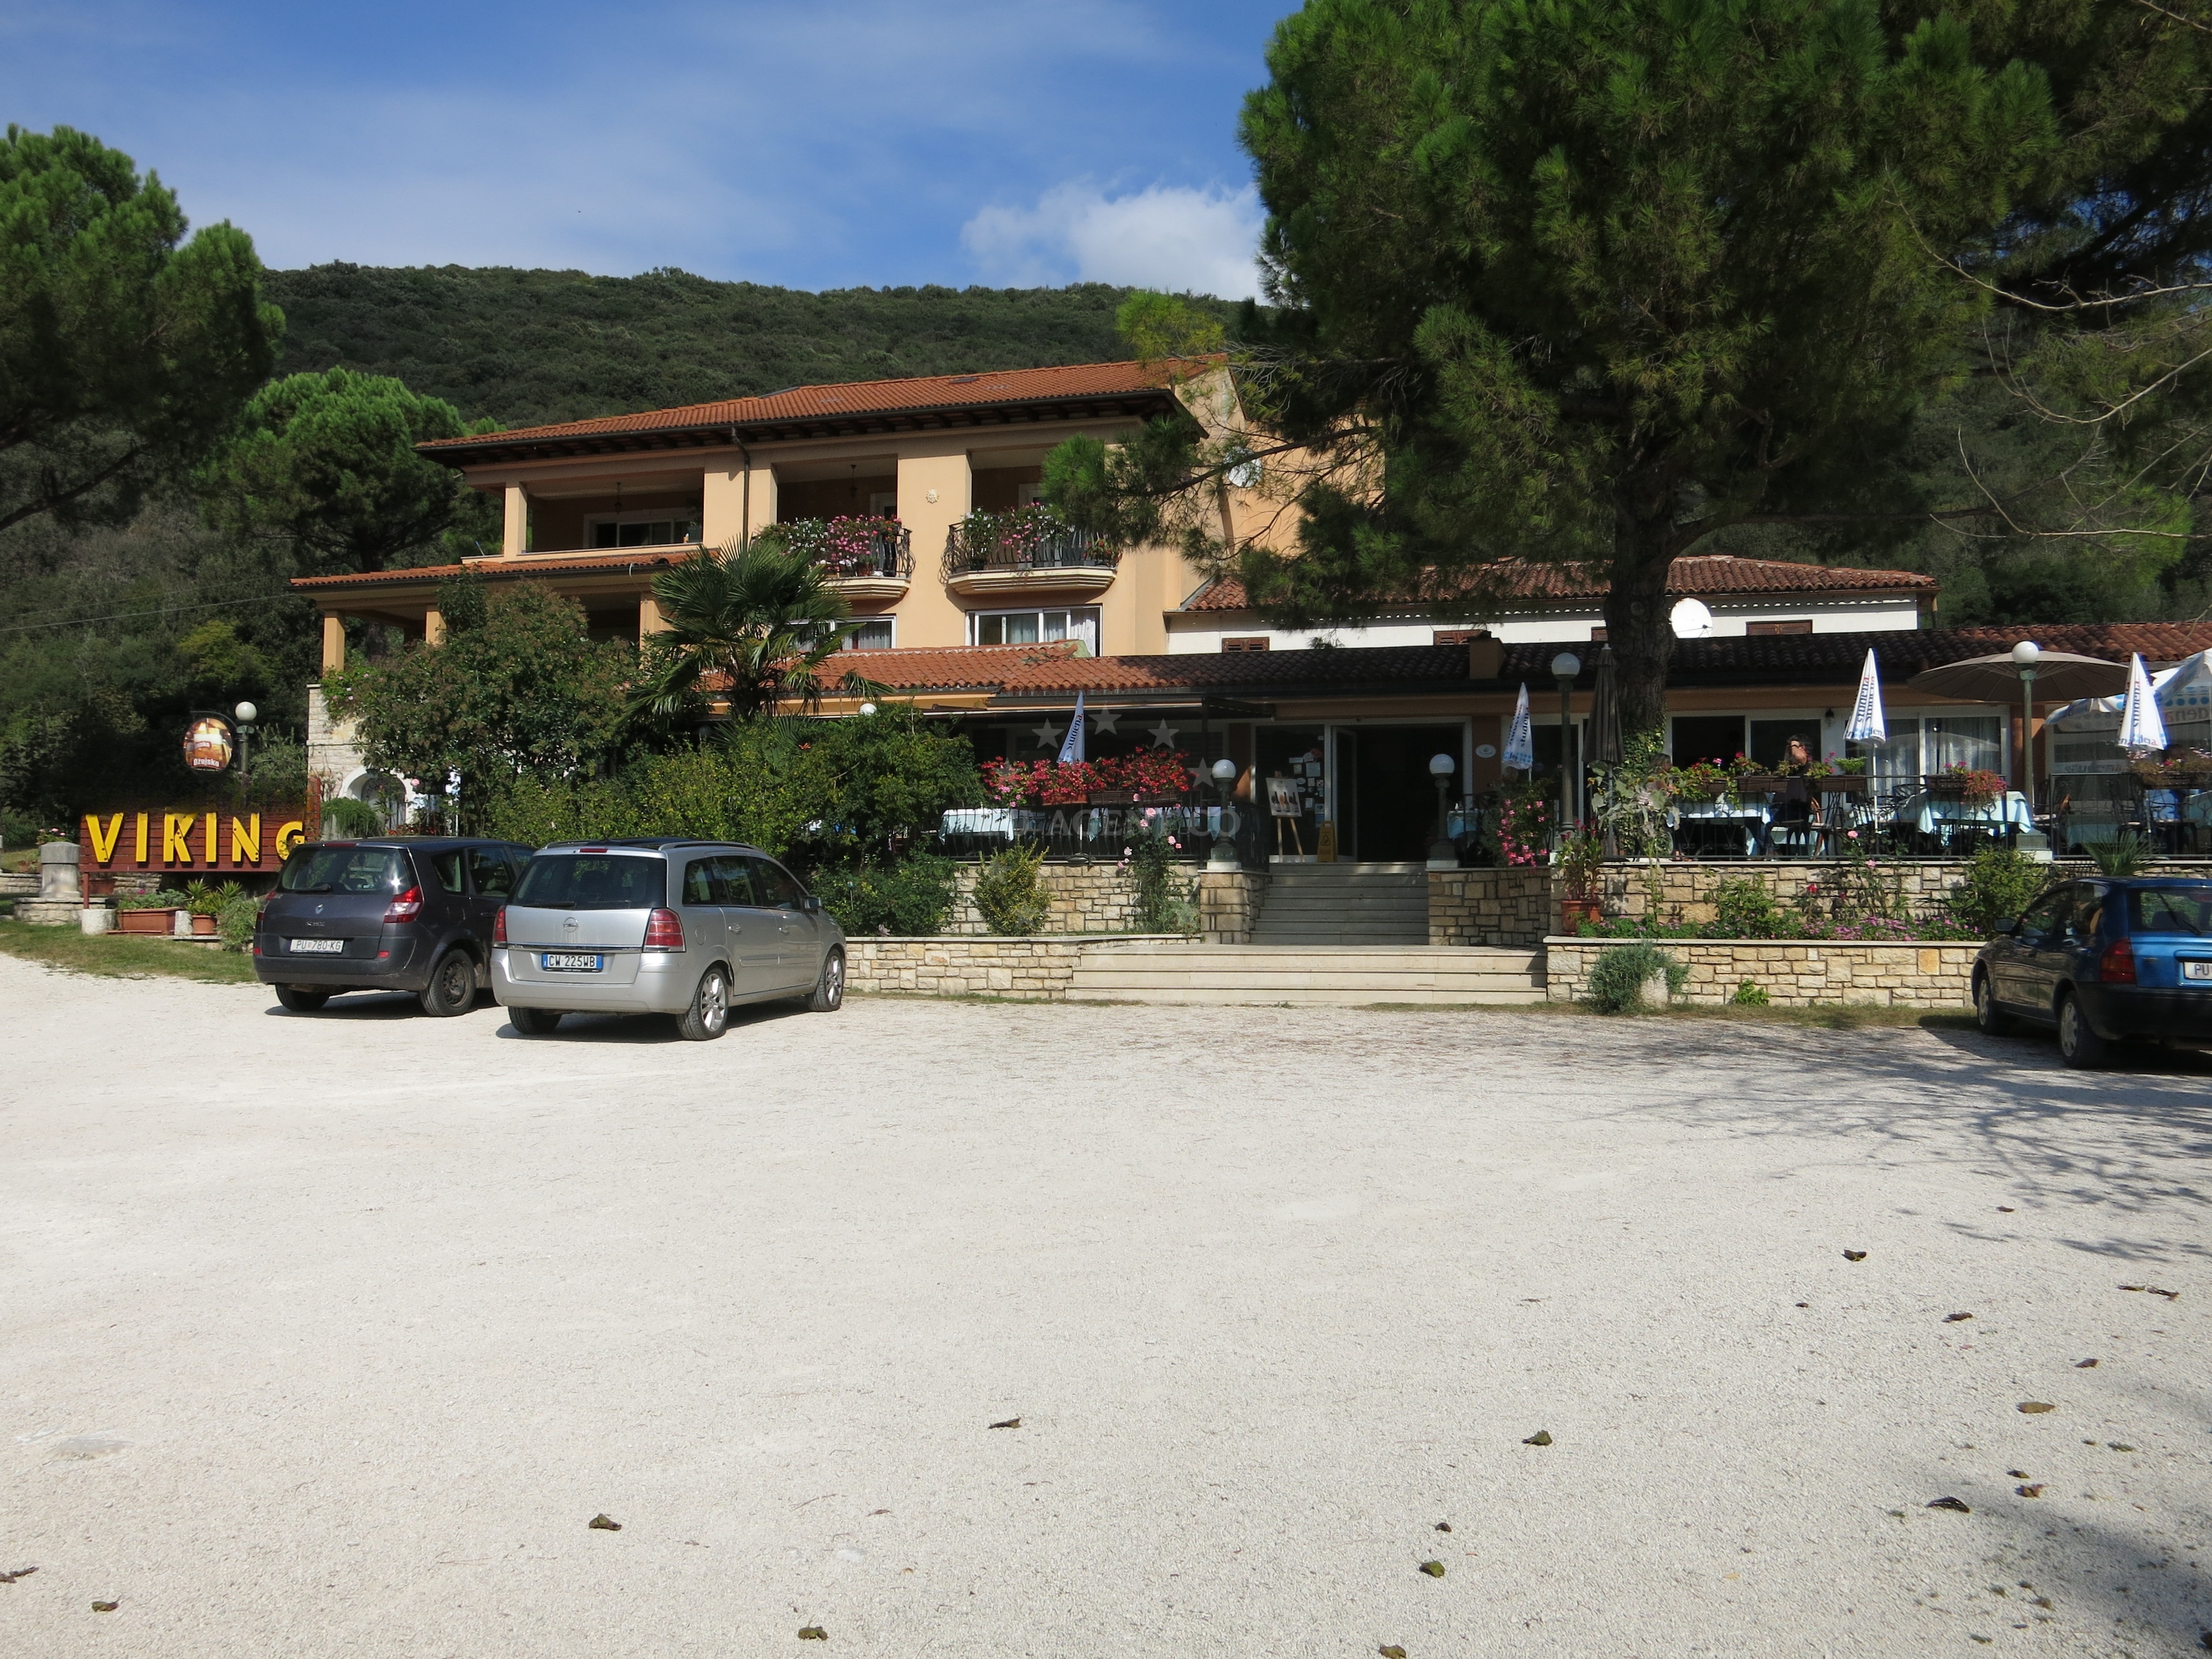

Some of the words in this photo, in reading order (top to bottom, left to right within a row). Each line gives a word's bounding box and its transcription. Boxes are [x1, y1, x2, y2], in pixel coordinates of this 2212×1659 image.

[85, 812, 305, 862] VIKING
[296, 940, 307, 950] PU
[549, 955, 561, 967] CW
[2194, 964, 2210, 975] PU
